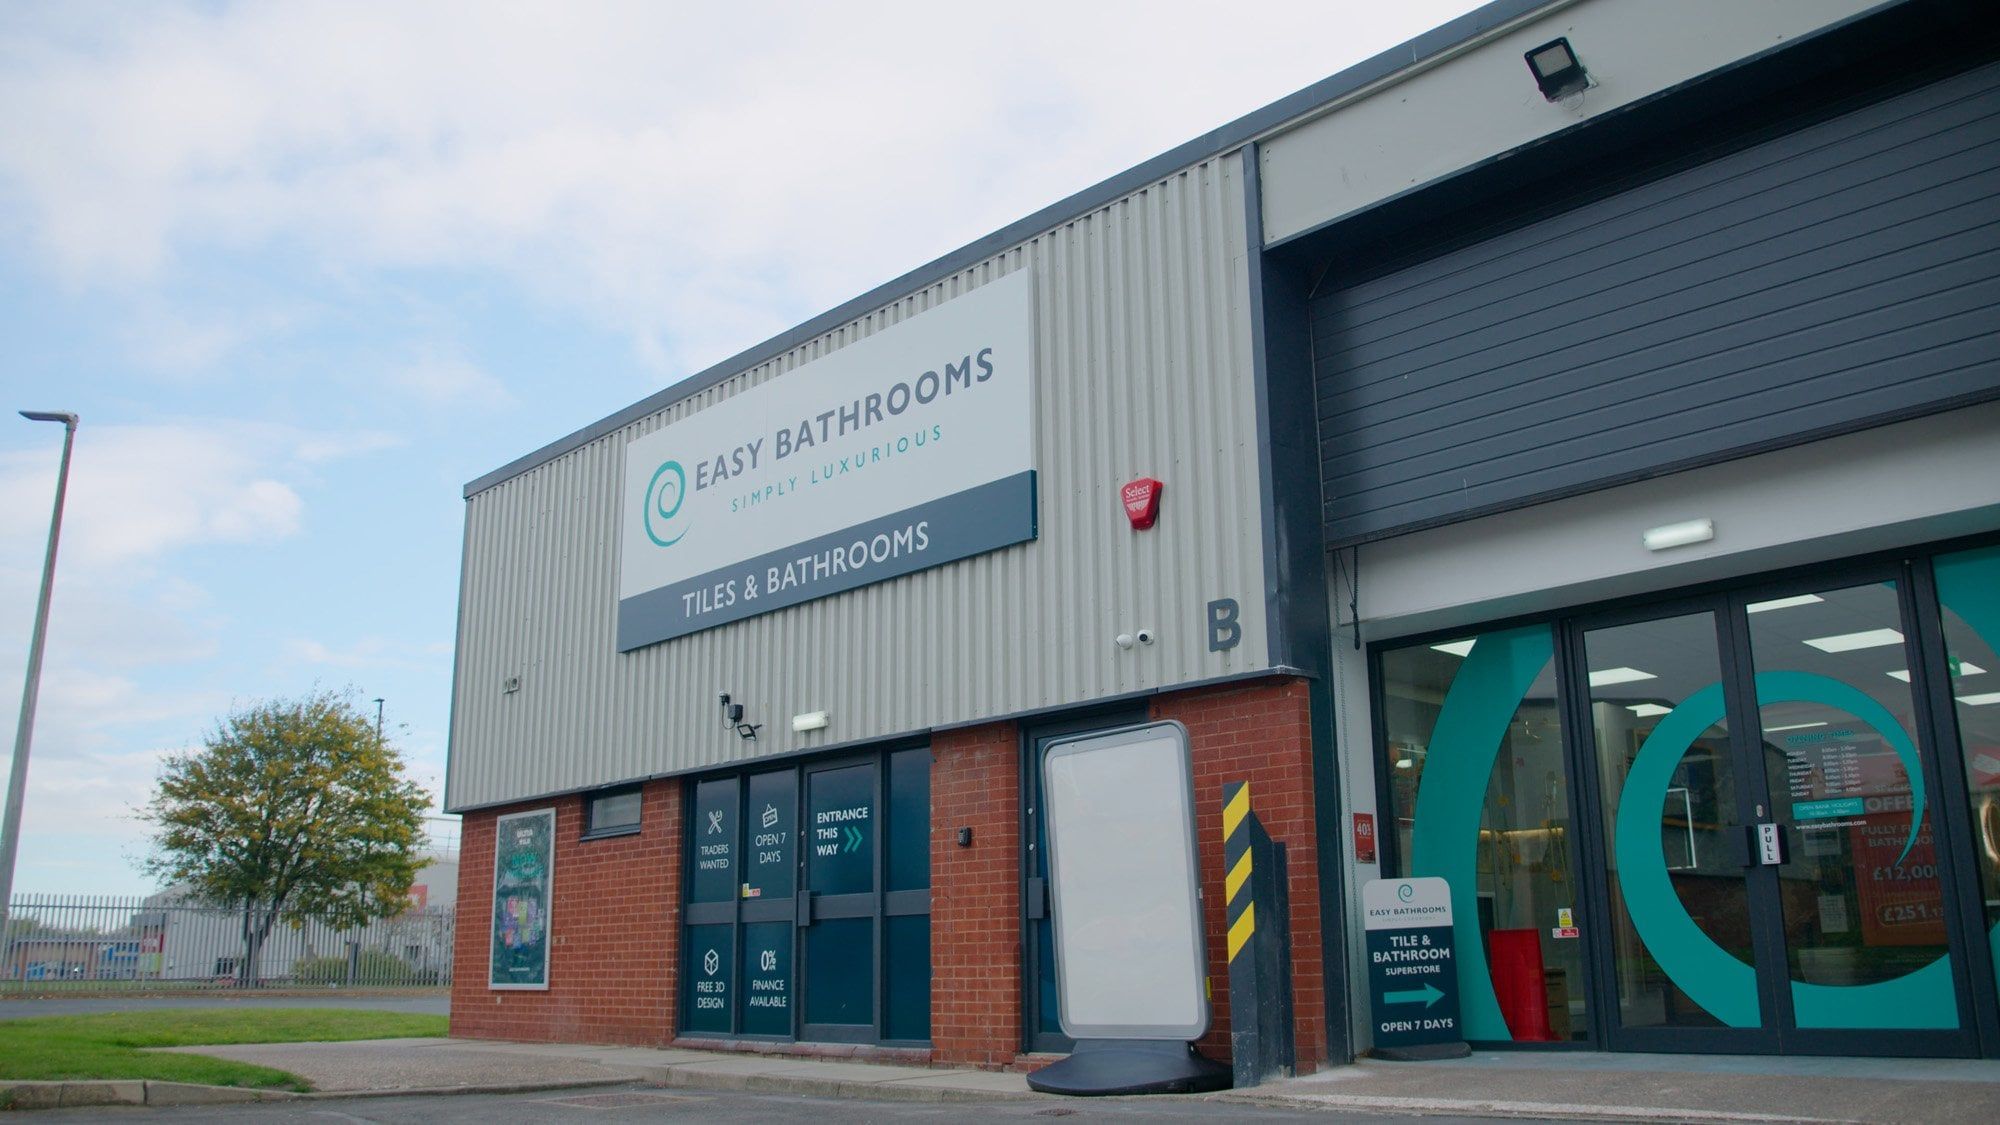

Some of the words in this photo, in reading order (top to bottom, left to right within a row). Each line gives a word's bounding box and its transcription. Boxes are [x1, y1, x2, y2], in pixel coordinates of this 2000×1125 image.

[695, 437, 764, 491] EASY
[776, 347, 994, 460] BATHROOMS
[732, 476, 797, 513] SIMPLY
[811, 424, 942, 485] LUXURIOUS
[1125, 484, 1150, 498] Select
[682, 579, 736, 618] TILES
[744, 574, 758, 600] &
[767, 521, 929, 594] BATHROOMS
[1207, 598, 1241, 653] B
[817, 807, 868, 824] ENTRANCE
[755, 833, 779, 847] OPEN
[781, 832, 787, 844] 7
[817, 827, 838, 840] THIS
[701, 844, 729, 856] TRADERS
[816, 844, 839, 856] WAY
[1764, 827, 1773, 861] PULL
[759, 850, 781, 864] DAYS
[700, 858, 729, 870] WANTED
[1370, 908, 1391, 916] EASY
[1394, 906, 1446, 915] BATHROOMS
[1390, 935, 1418, 948] TILE
[1422, 935, 1431, 946] &
[1373, 948, 1450, 963] BATHROOM
[1385, 965, 1441, 976] SUPERSTORE
[697, 981, 713, 993] FREE
[714, 981, 725, 992] 3D
[752, 979, 784, 991] FINANCE
[697, 997, 724, 1009] DESIGN
[749, 996, 786, 1007] AVAILABLE
[1381, 1020, 1412, 1032] OPEN
[1414, 1020, 1421, 1030] 7
[1424, 1018, 1453, 1029] DAYS
